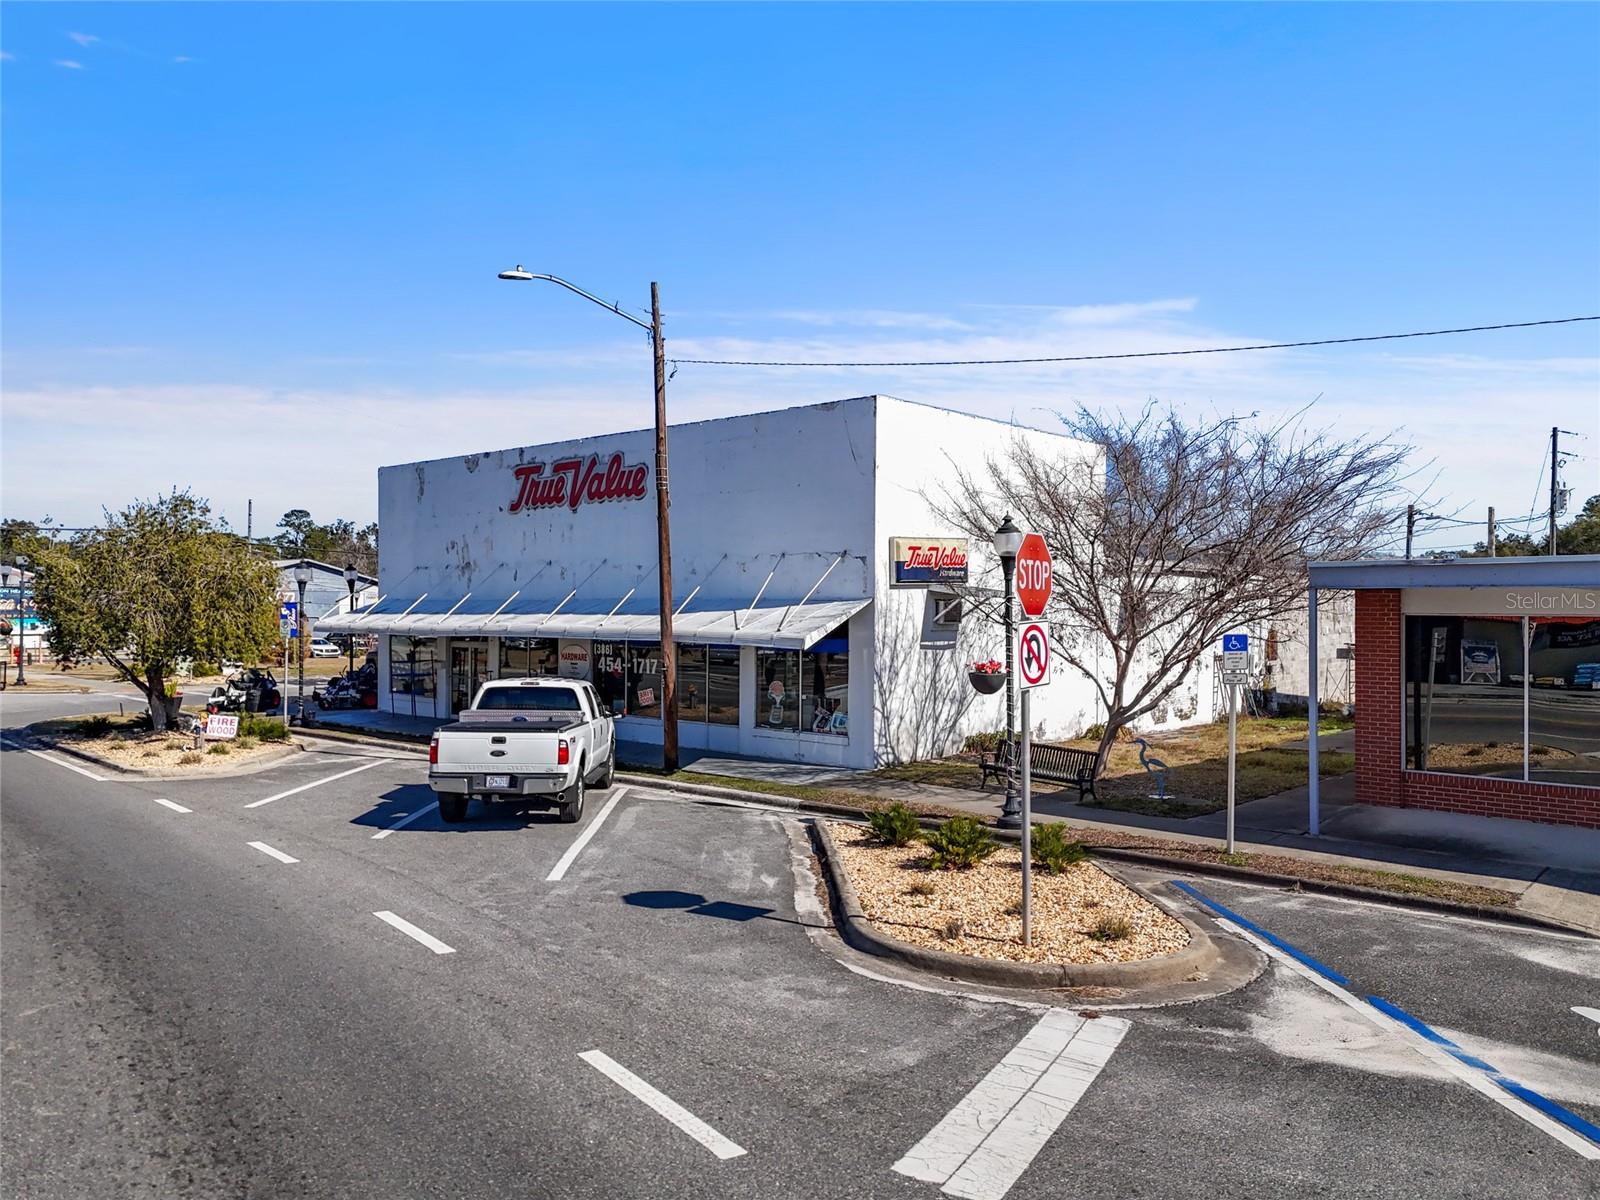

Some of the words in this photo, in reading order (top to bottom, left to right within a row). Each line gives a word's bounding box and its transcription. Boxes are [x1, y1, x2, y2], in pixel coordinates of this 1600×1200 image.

[509, 464, 566, 512] True
[552, 453, 647, 509] Value
[905, 546, 934, 568] True
[927, 544, 967, 570] Value
[939, 569, 965, 578] Hardware
[1018, 558, 1050, 591] STOP
[594, 643, 613, 655] (386)
[560, 652, 588, 662] HARDWARE
[598, 657, 658, 674] 454-1717
[210, 717, 236, 727] FIRE
[208, 726, 235, 736] WOOD
